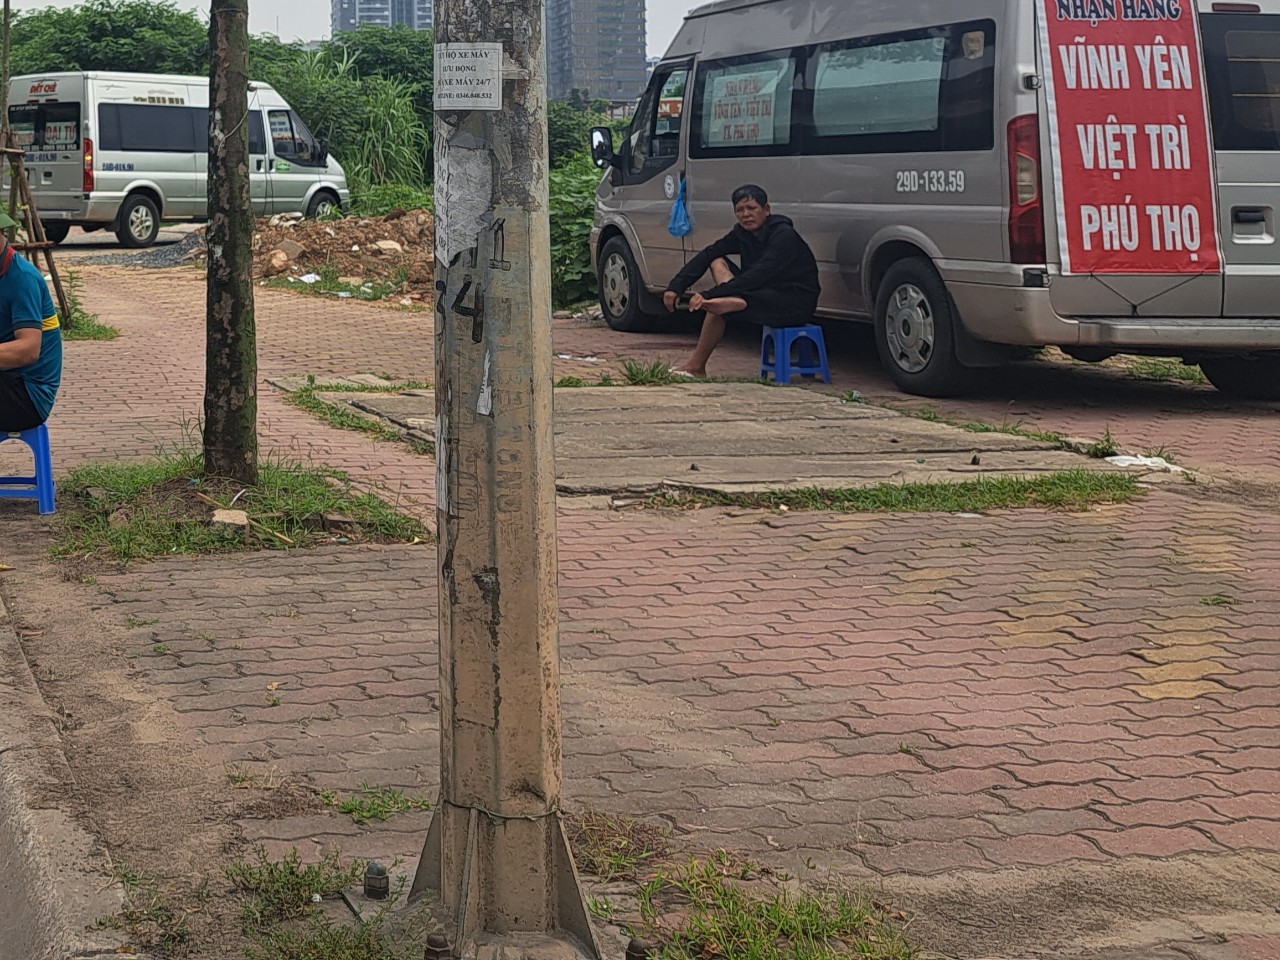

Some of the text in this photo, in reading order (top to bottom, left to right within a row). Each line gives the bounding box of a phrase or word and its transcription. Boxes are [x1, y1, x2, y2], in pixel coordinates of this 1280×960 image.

[475, 78, 491, 86] 24/7
[1058, 35, 1193, 89] VĨNH YÊN
[1076, 114, 1191, 180] VIỆT TRÌ
[896, 170, 965, 192] 29D-133.59
[1080, 194, 1201, 261] PHÚ THỌ
